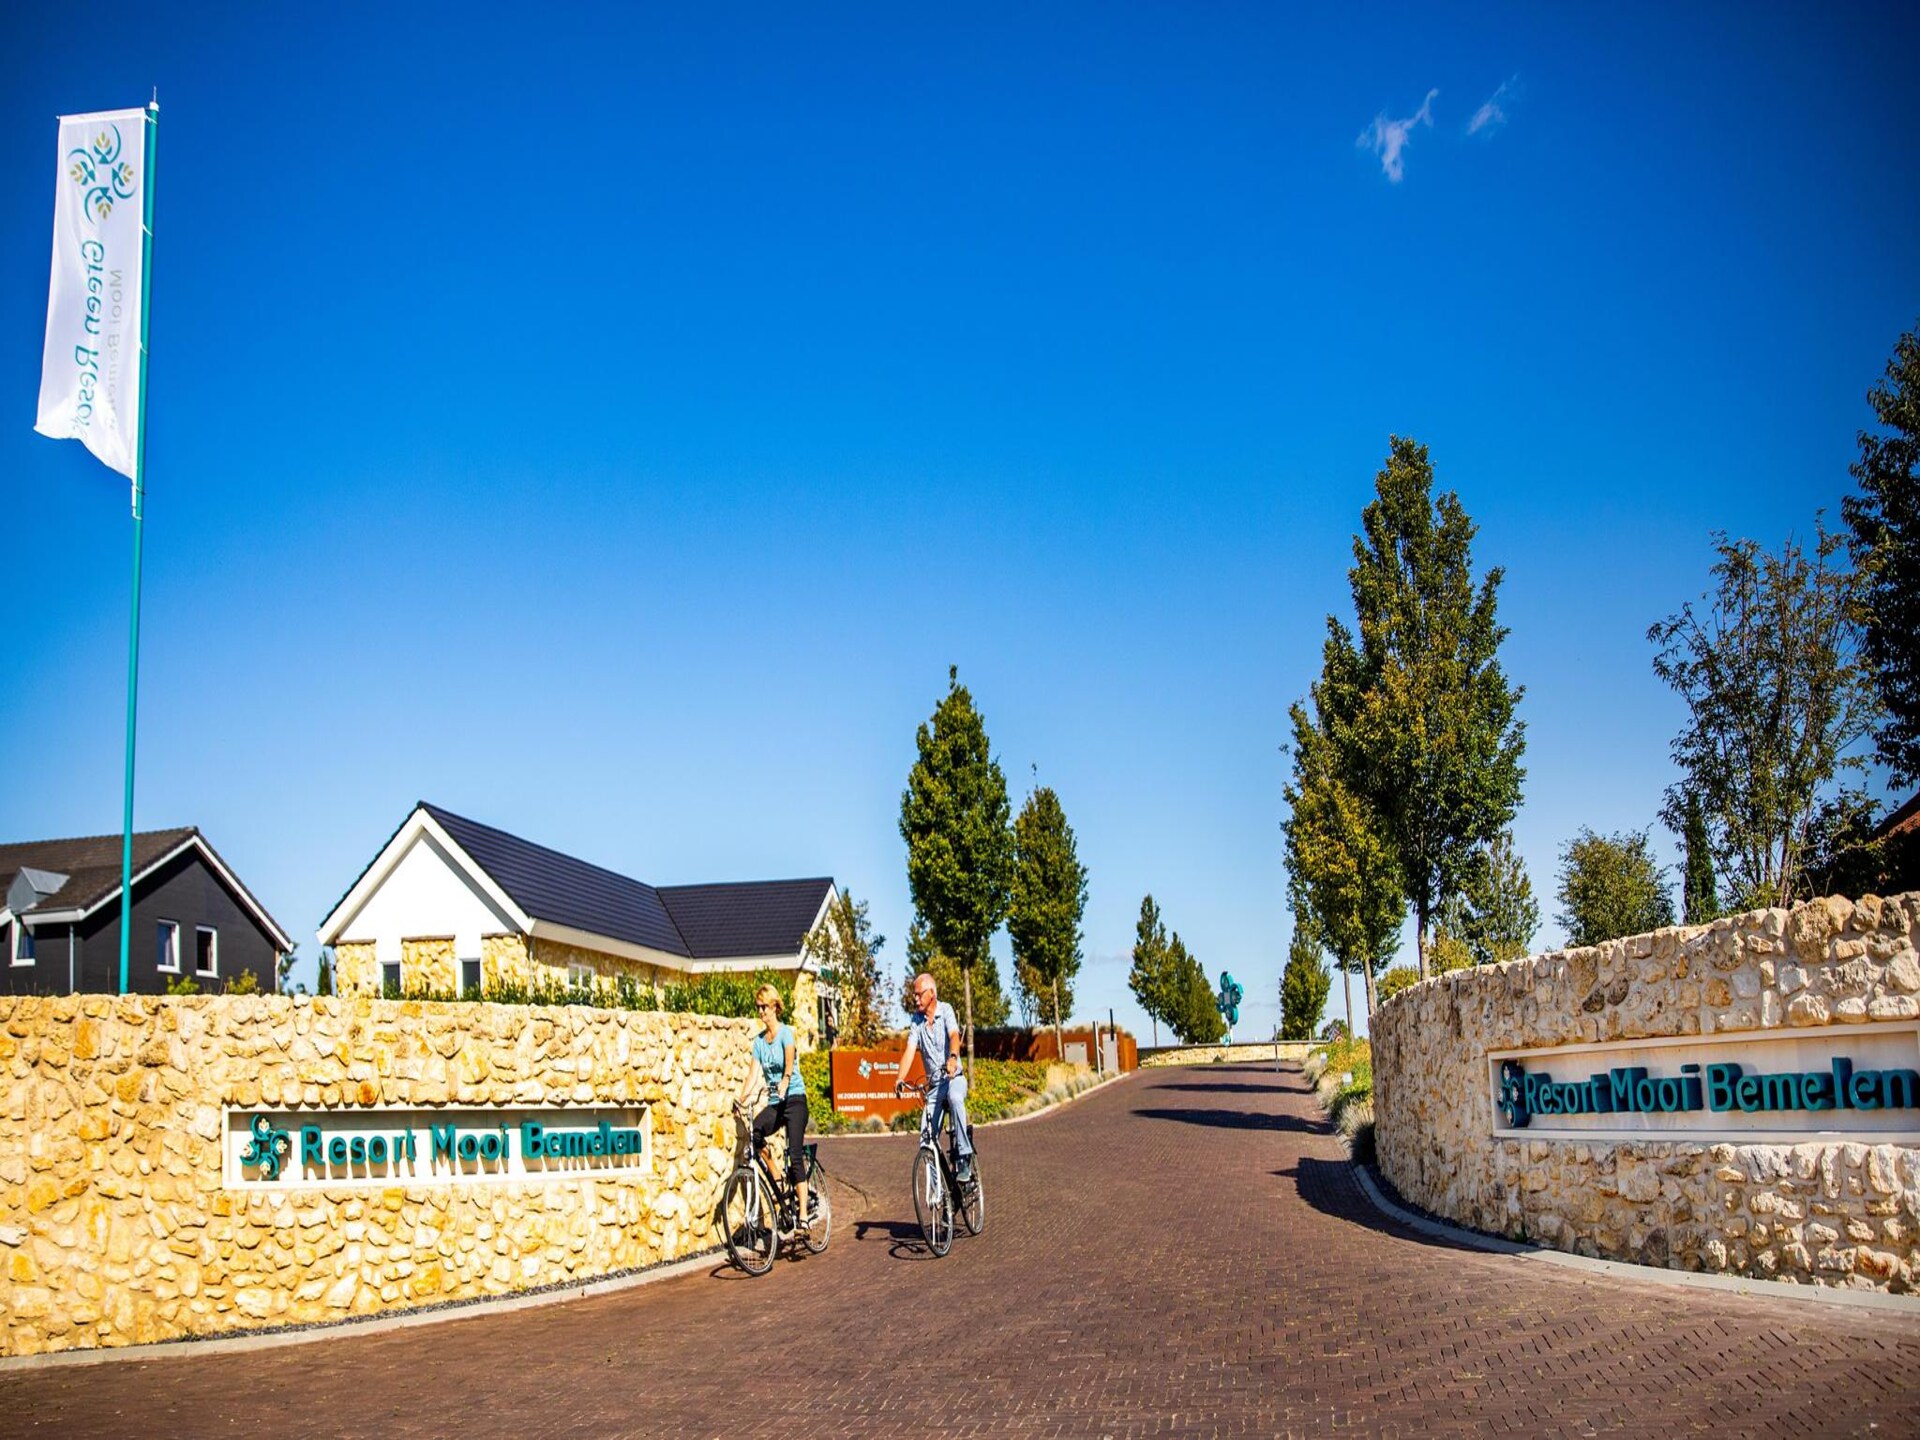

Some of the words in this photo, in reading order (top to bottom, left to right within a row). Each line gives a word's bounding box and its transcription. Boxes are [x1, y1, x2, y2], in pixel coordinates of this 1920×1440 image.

[1525, 1071, 1611, 1115] Resort
[1609, 1064, 1703, 1113] Mooi
[1706, 1056, 1920, 1113] Bemelen
[301, 1124, 417, 1166] Resort
[429, 1122, 510, 1163] Mooi
[520, 1119, 642, 1159] Bemelen
